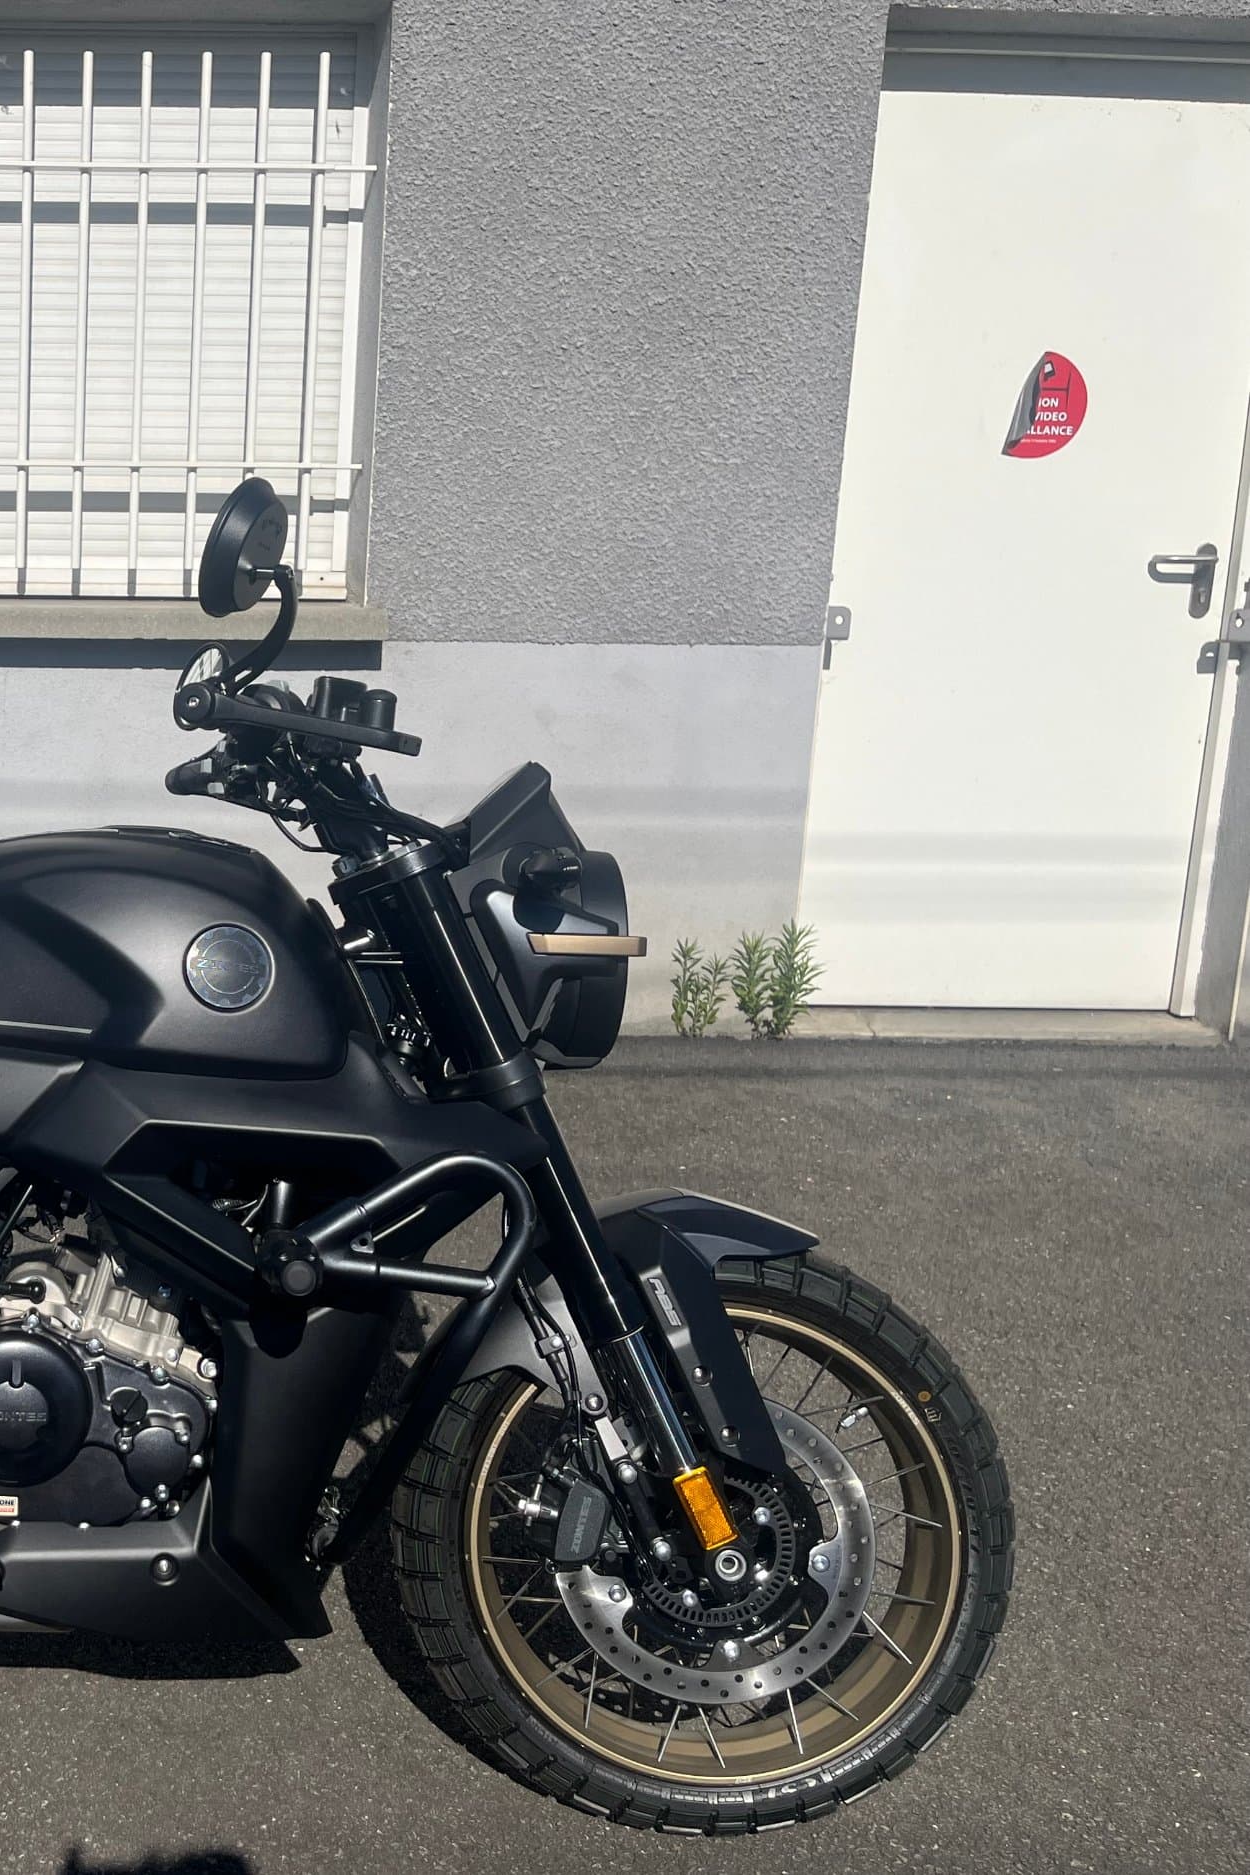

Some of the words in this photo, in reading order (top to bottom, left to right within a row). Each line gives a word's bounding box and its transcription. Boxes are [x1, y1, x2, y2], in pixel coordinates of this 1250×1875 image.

[1027, 426, 1074, 435] LLANCE
[648, 1278, 683, 1327] ABS
[571, 1496, 592, 1554] ZONTES
